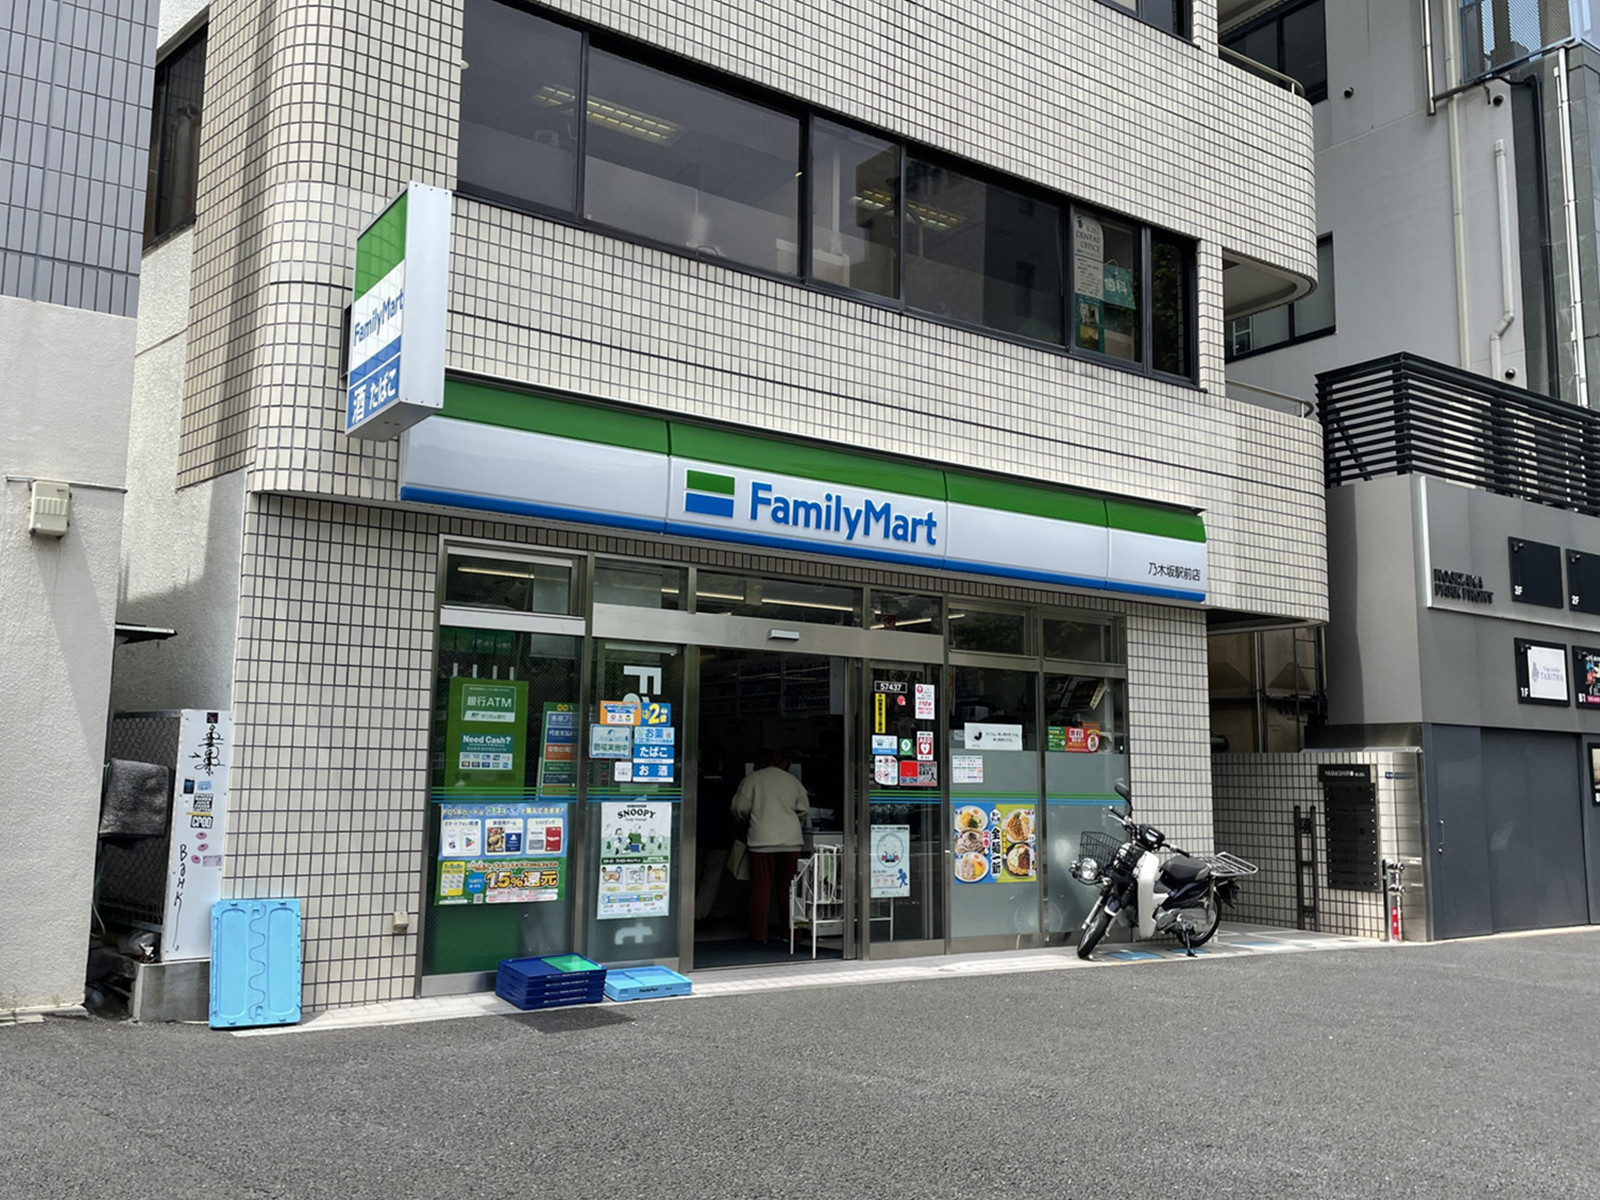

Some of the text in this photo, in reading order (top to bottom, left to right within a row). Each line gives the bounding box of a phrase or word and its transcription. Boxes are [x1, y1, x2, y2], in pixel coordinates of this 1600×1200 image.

[1076, 230, 1100, 243] DENTAL
[1080, 241, 1100, 253] OFFICE
[354, 289, 403, 346] FamilyMart
[352, 367, 397, 424] 酒 たばこ
[750, 481, 938, 546] FamilyMart
[1147, 562, 1201, 582] 乃木坂駅前店
[1520, 687, 1529, 698] 1F
[467, 695, 513, 708] 銀行ATM
[463, 735, 483, 744] Need
[486, 736, 511, 745] Cash?
[639, 746, 668, 758] たばこ
[617, 808, 656, 819] SNOOPY
